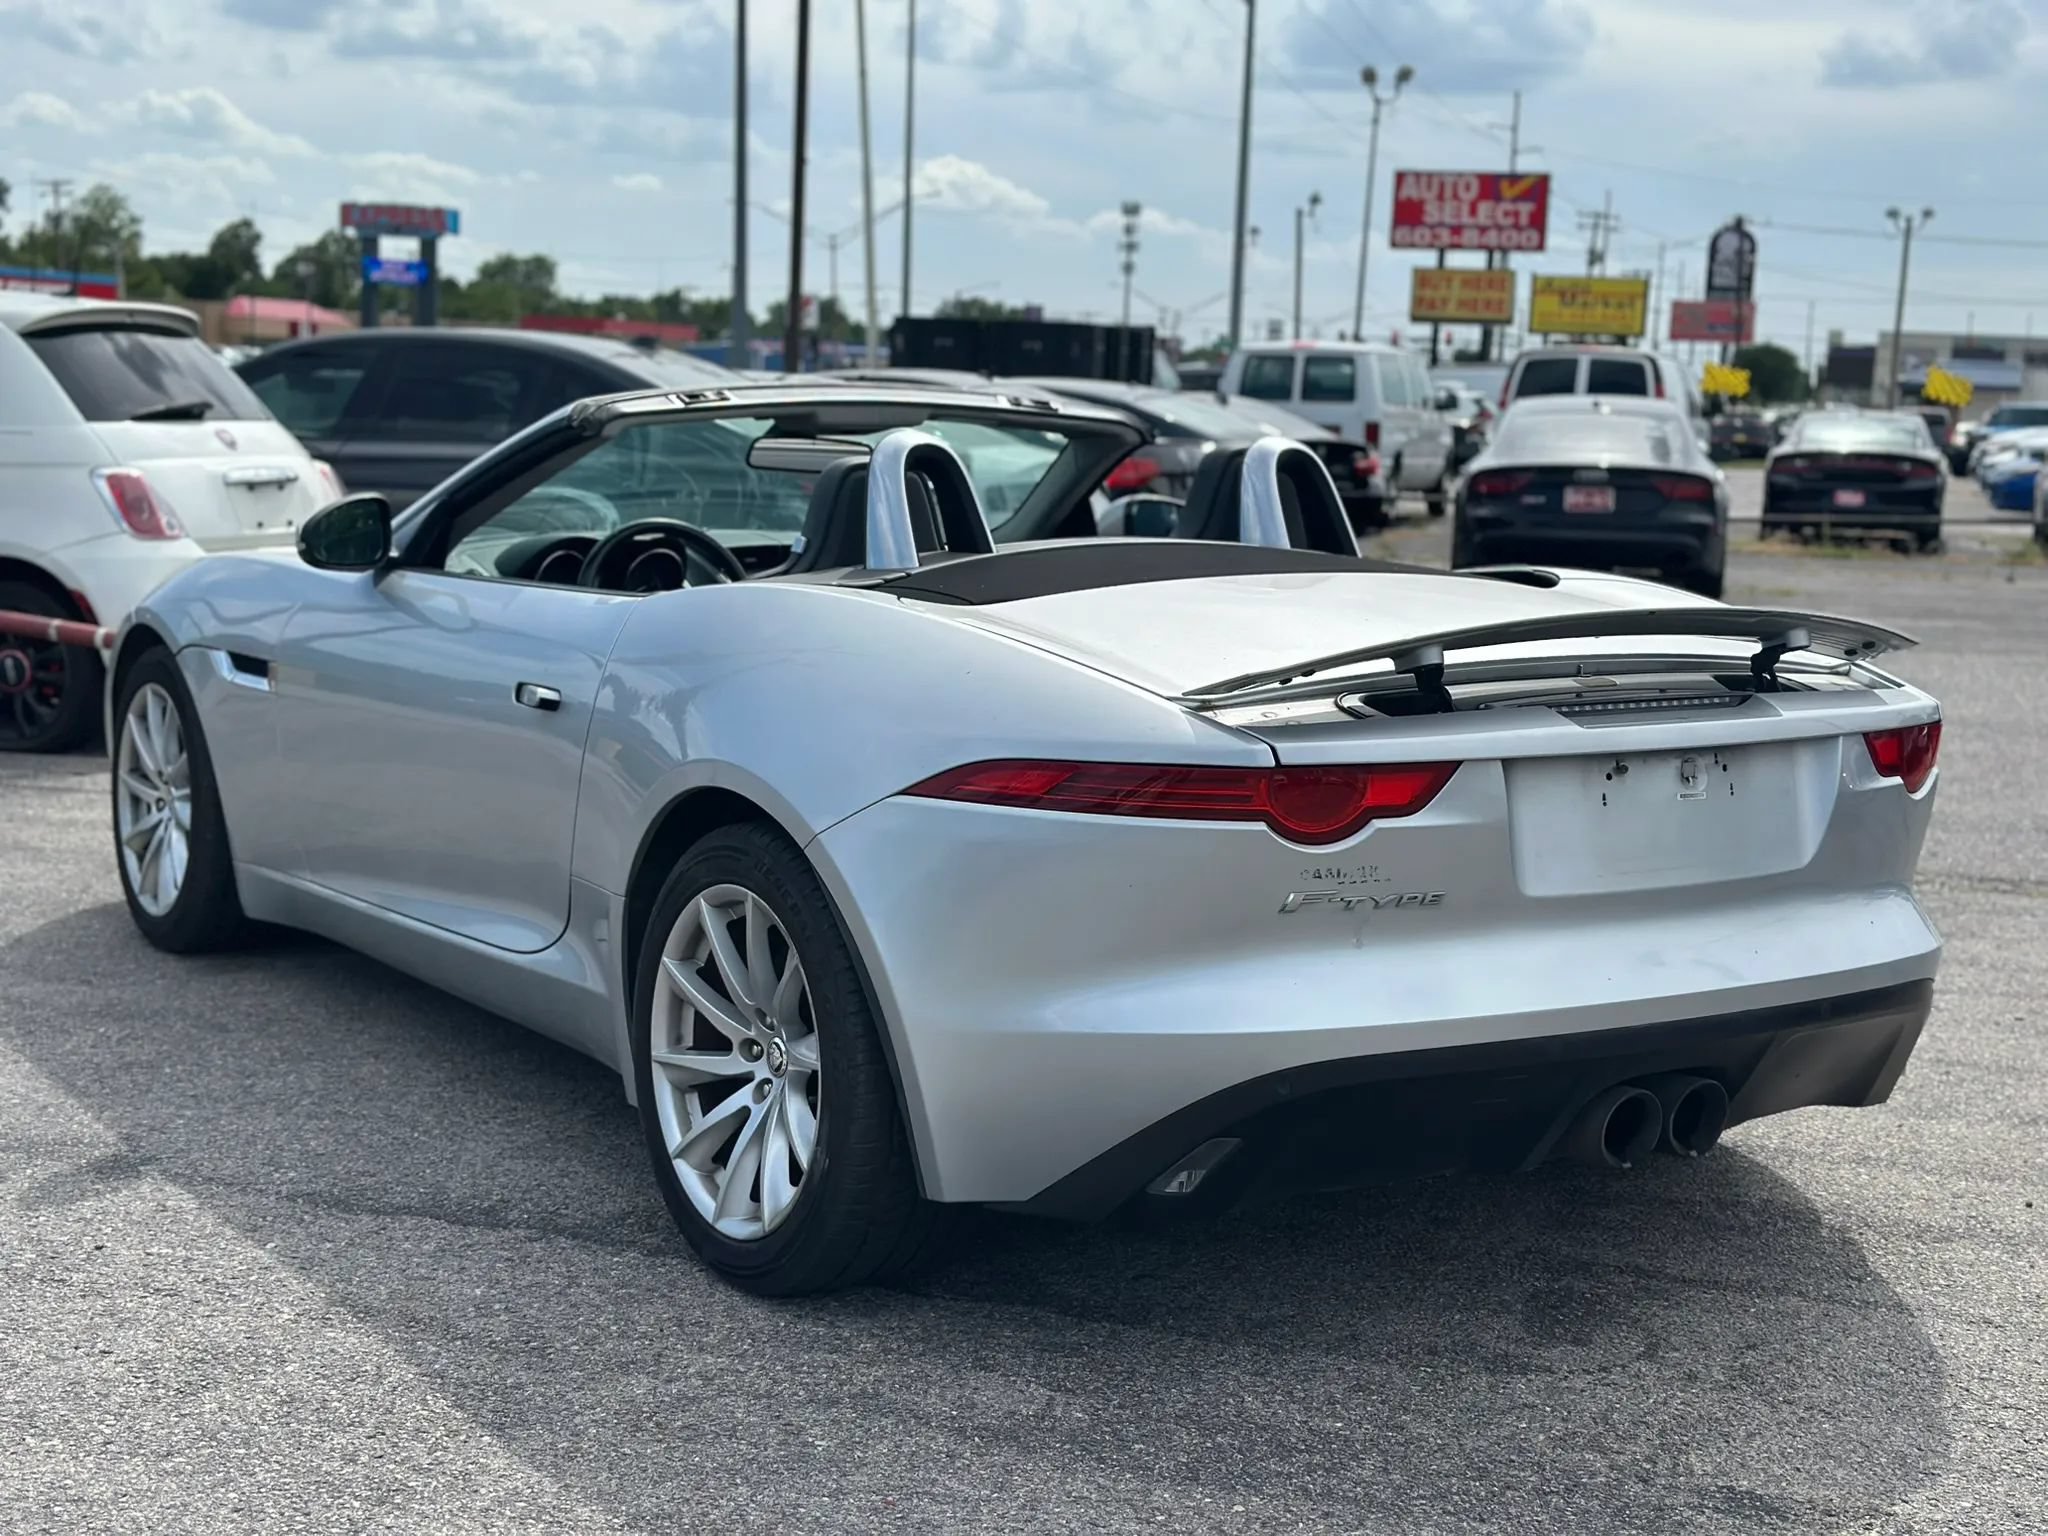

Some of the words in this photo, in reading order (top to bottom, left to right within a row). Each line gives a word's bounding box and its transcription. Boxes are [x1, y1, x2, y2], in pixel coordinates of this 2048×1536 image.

[1398, 174, 1480, 200] AUTO
[1422, 199, 1538, 226] SELECT
[1394, 225, 1541, 247] 603-8400
[1418, 276, 1453, 291] BUY
[1461, 276, 1508, 292] HERE
[1416, 296, 1452, 312] PAY
[1458, 297, 1507, 314] HERE
[1278, 890, 1448, 913] F-TYPE
